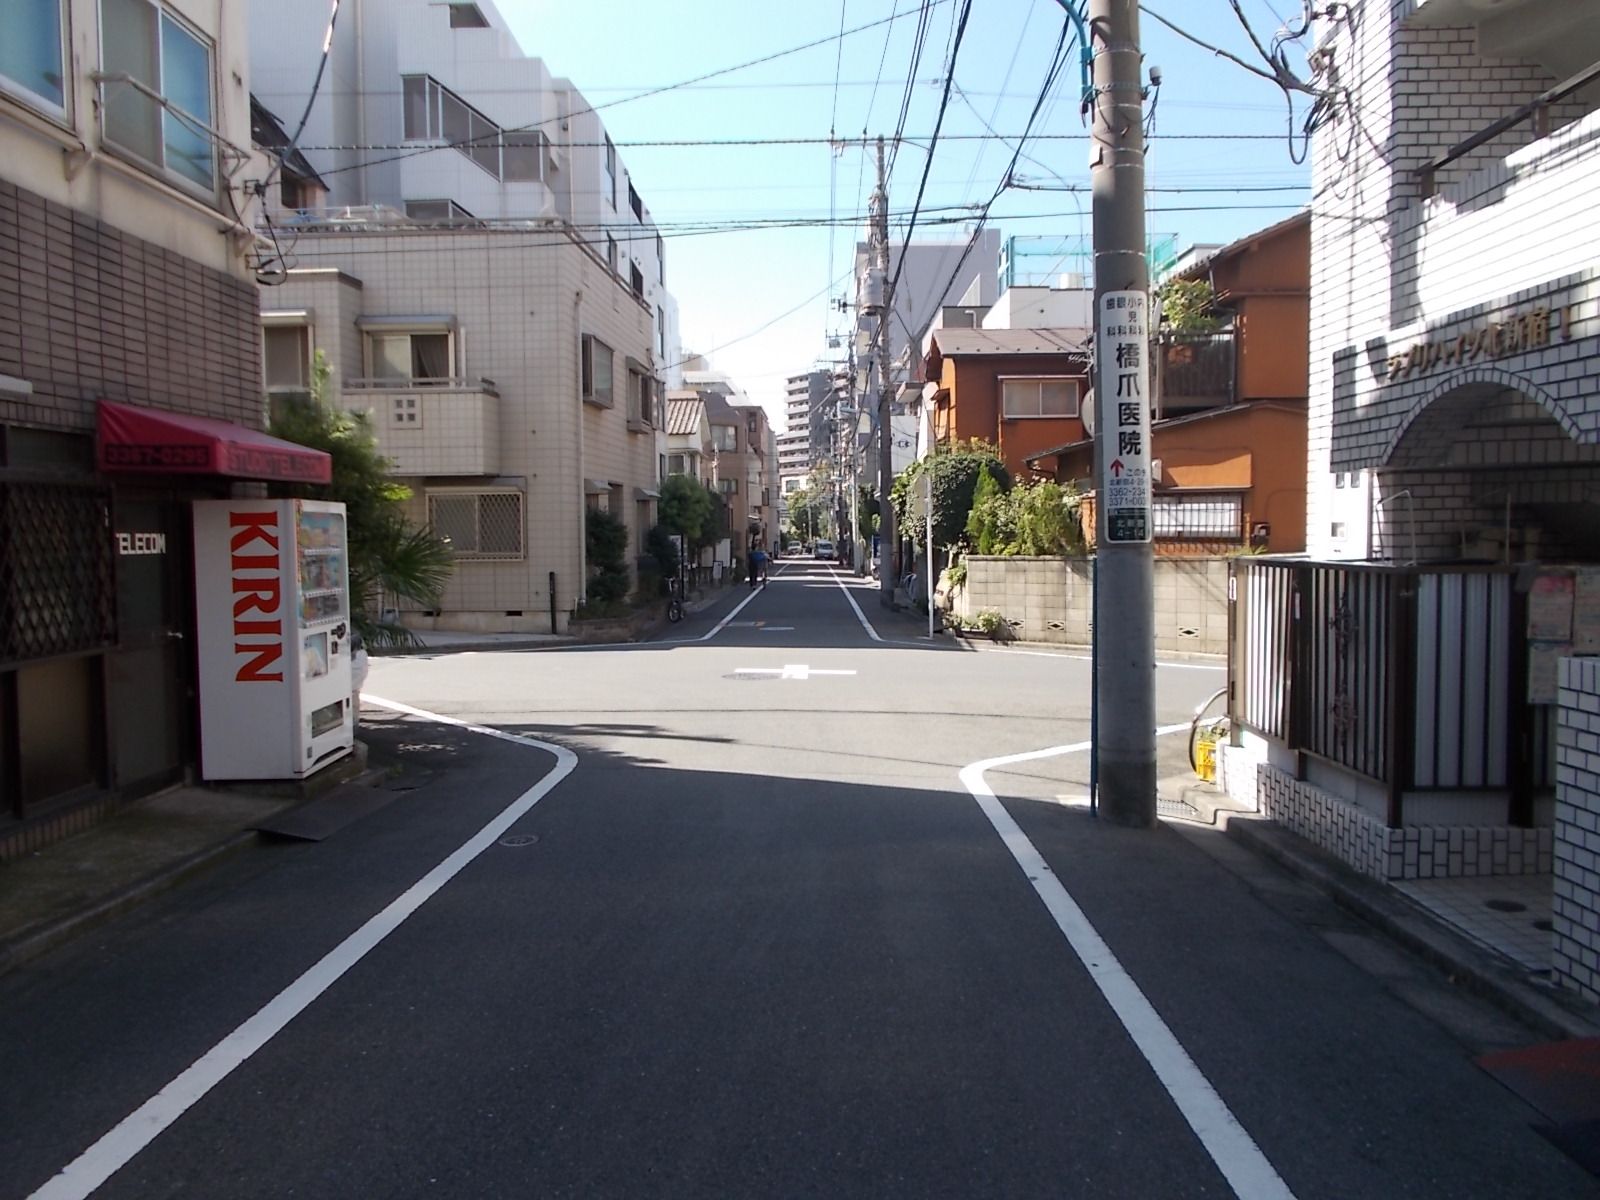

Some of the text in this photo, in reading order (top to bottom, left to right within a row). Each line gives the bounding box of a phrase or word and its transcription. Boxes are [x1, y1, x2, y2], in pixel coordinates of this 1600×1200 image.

[1115, 342, 1141, 457] 橋爪医院
[115, 532, 167, 555] ELECOM
[229, 511, 284, 683] KIRIN
